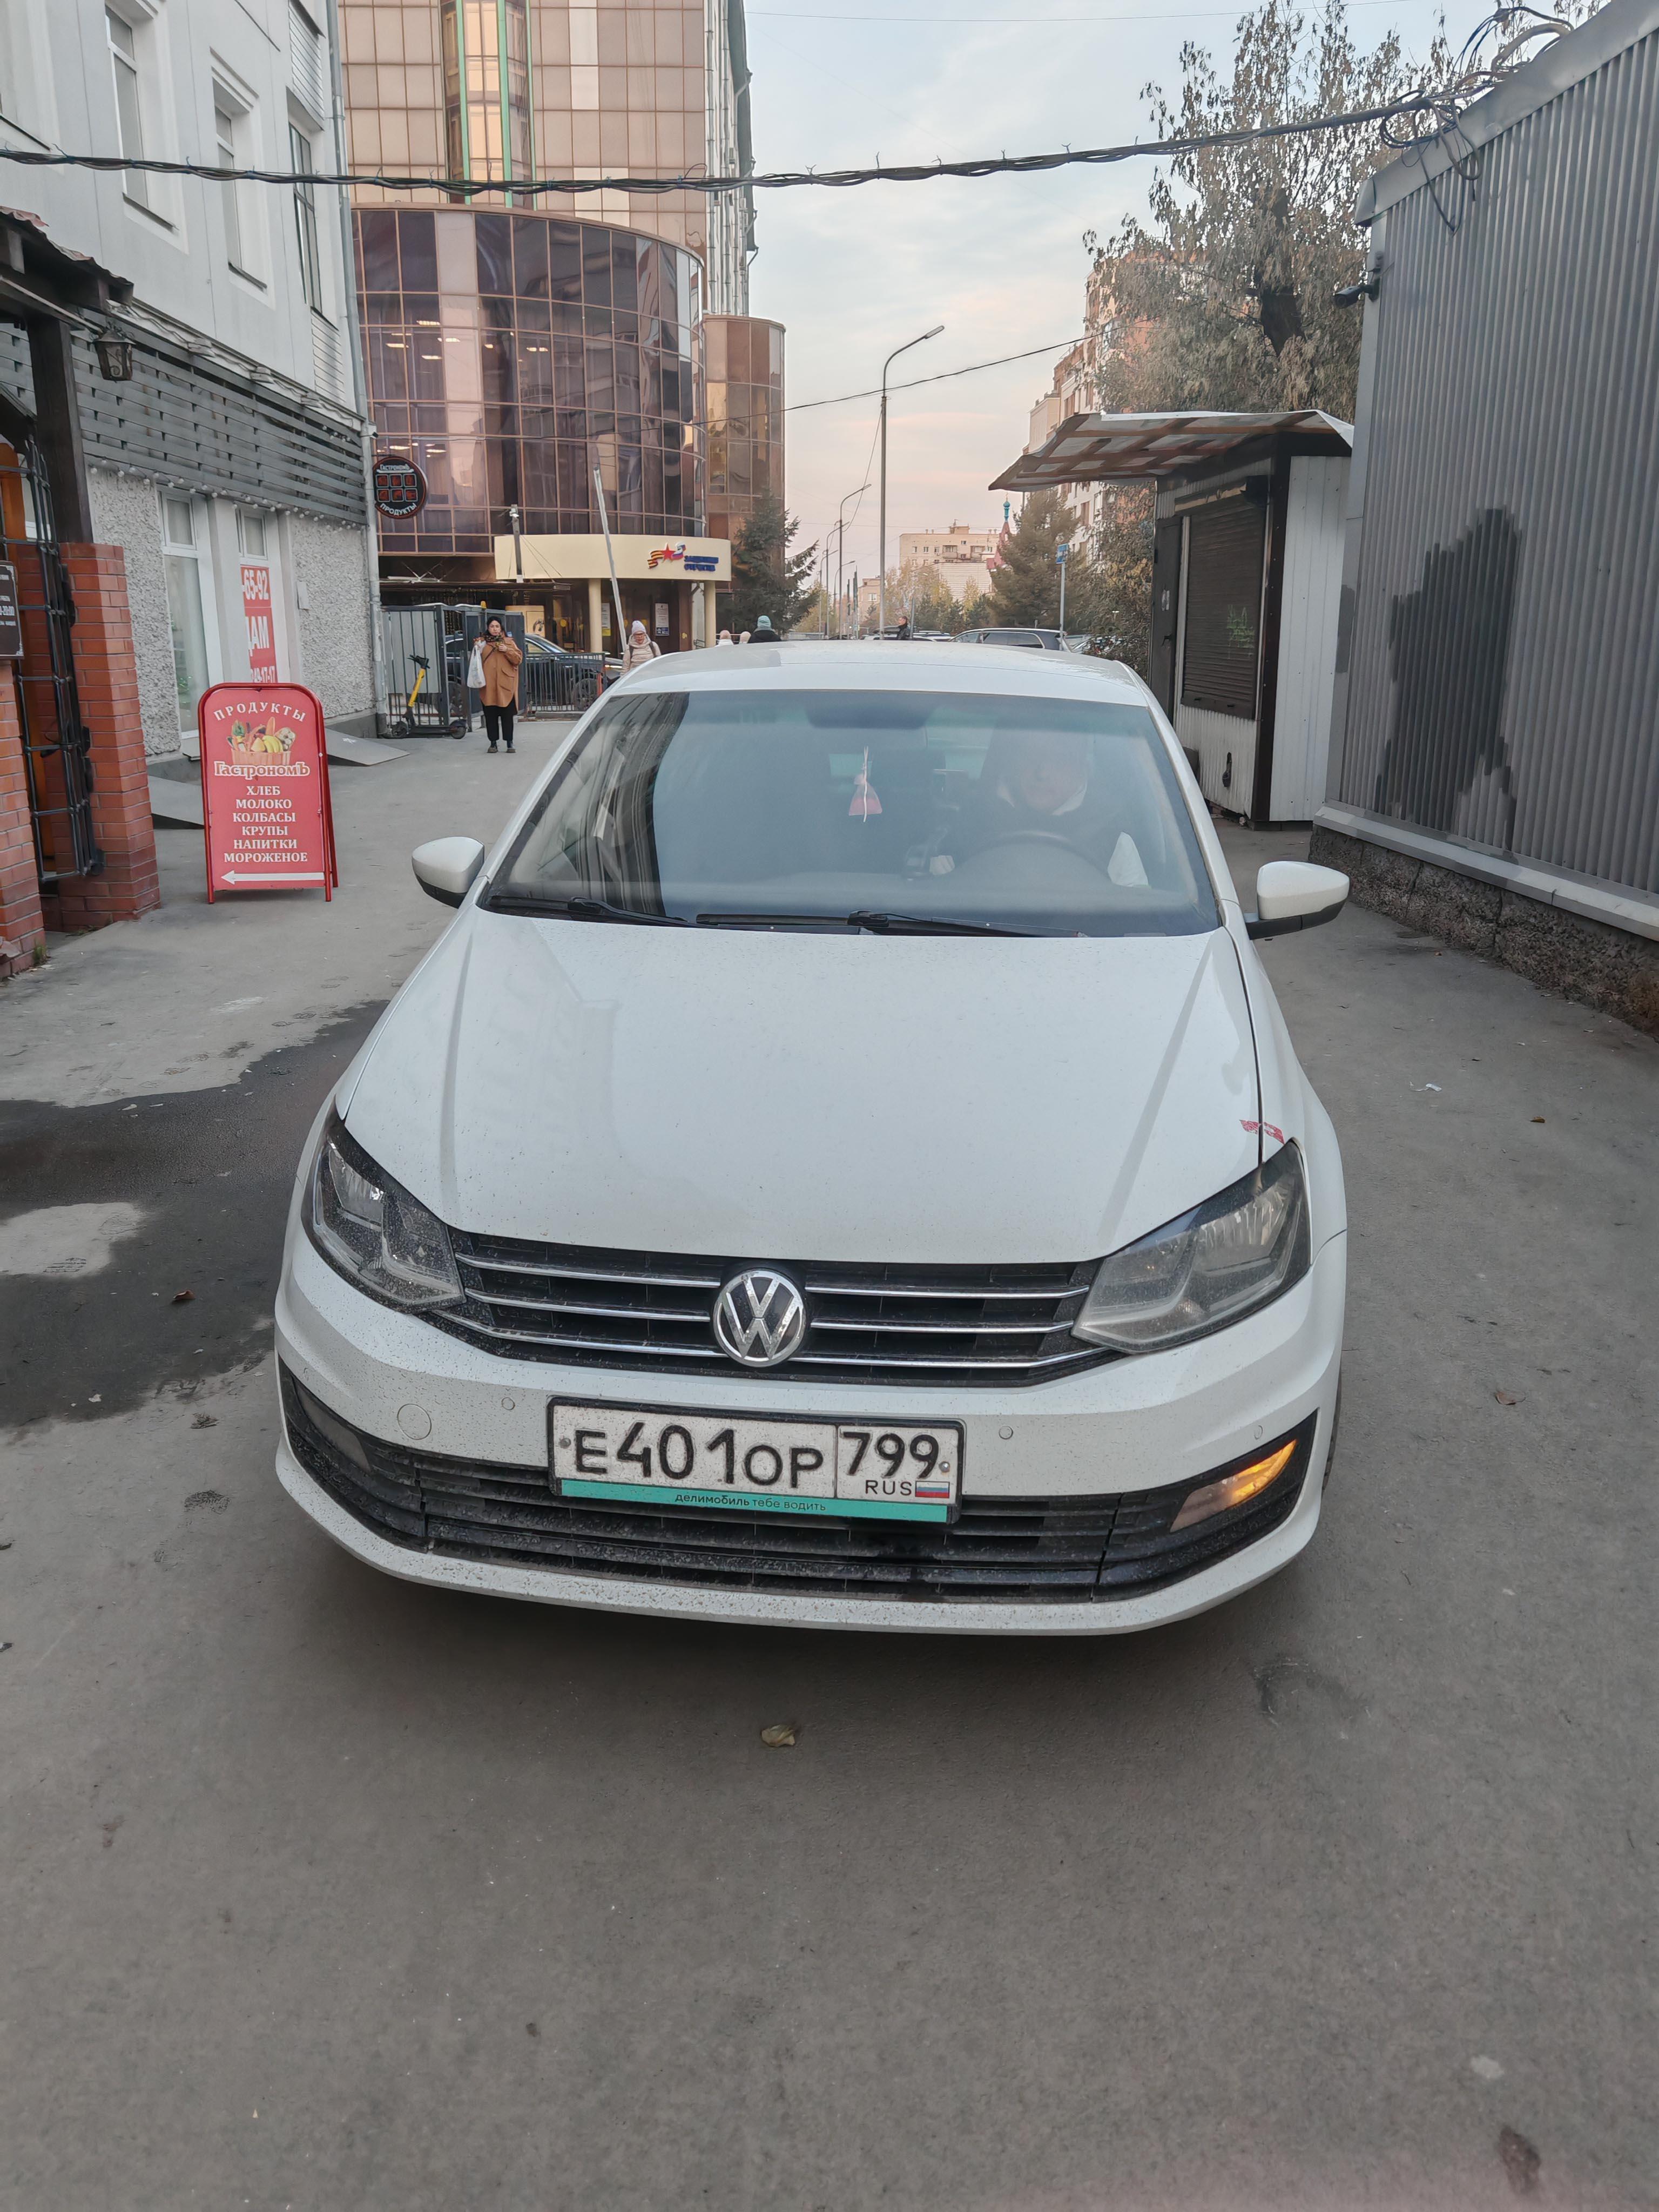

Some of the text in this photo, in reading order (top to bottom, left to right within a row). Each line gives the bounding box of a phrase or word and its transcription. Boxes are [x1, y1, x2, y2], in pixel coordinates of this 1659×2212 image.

[380, 502, 417, 515] ПРОДУКТЫ
[213, 702, 306, 722] ПРОДУКТЫ
[246, 786, 280, 795] ХЛЕБ
[235, 799, 292, 809] МОЛОКО
[233, 812, 296, 822] КОЛБАСЫ
[241, 826, 288, 836] КРУПЫ
[233, 839, 297, 849] НАПИТКИ
[224, 852, 308, 862] МОРОЖЕНОЕ
[865, 1480, 913, 1496] RUS
[675, 1489, 826, 1512] делимобиль тебе водить
